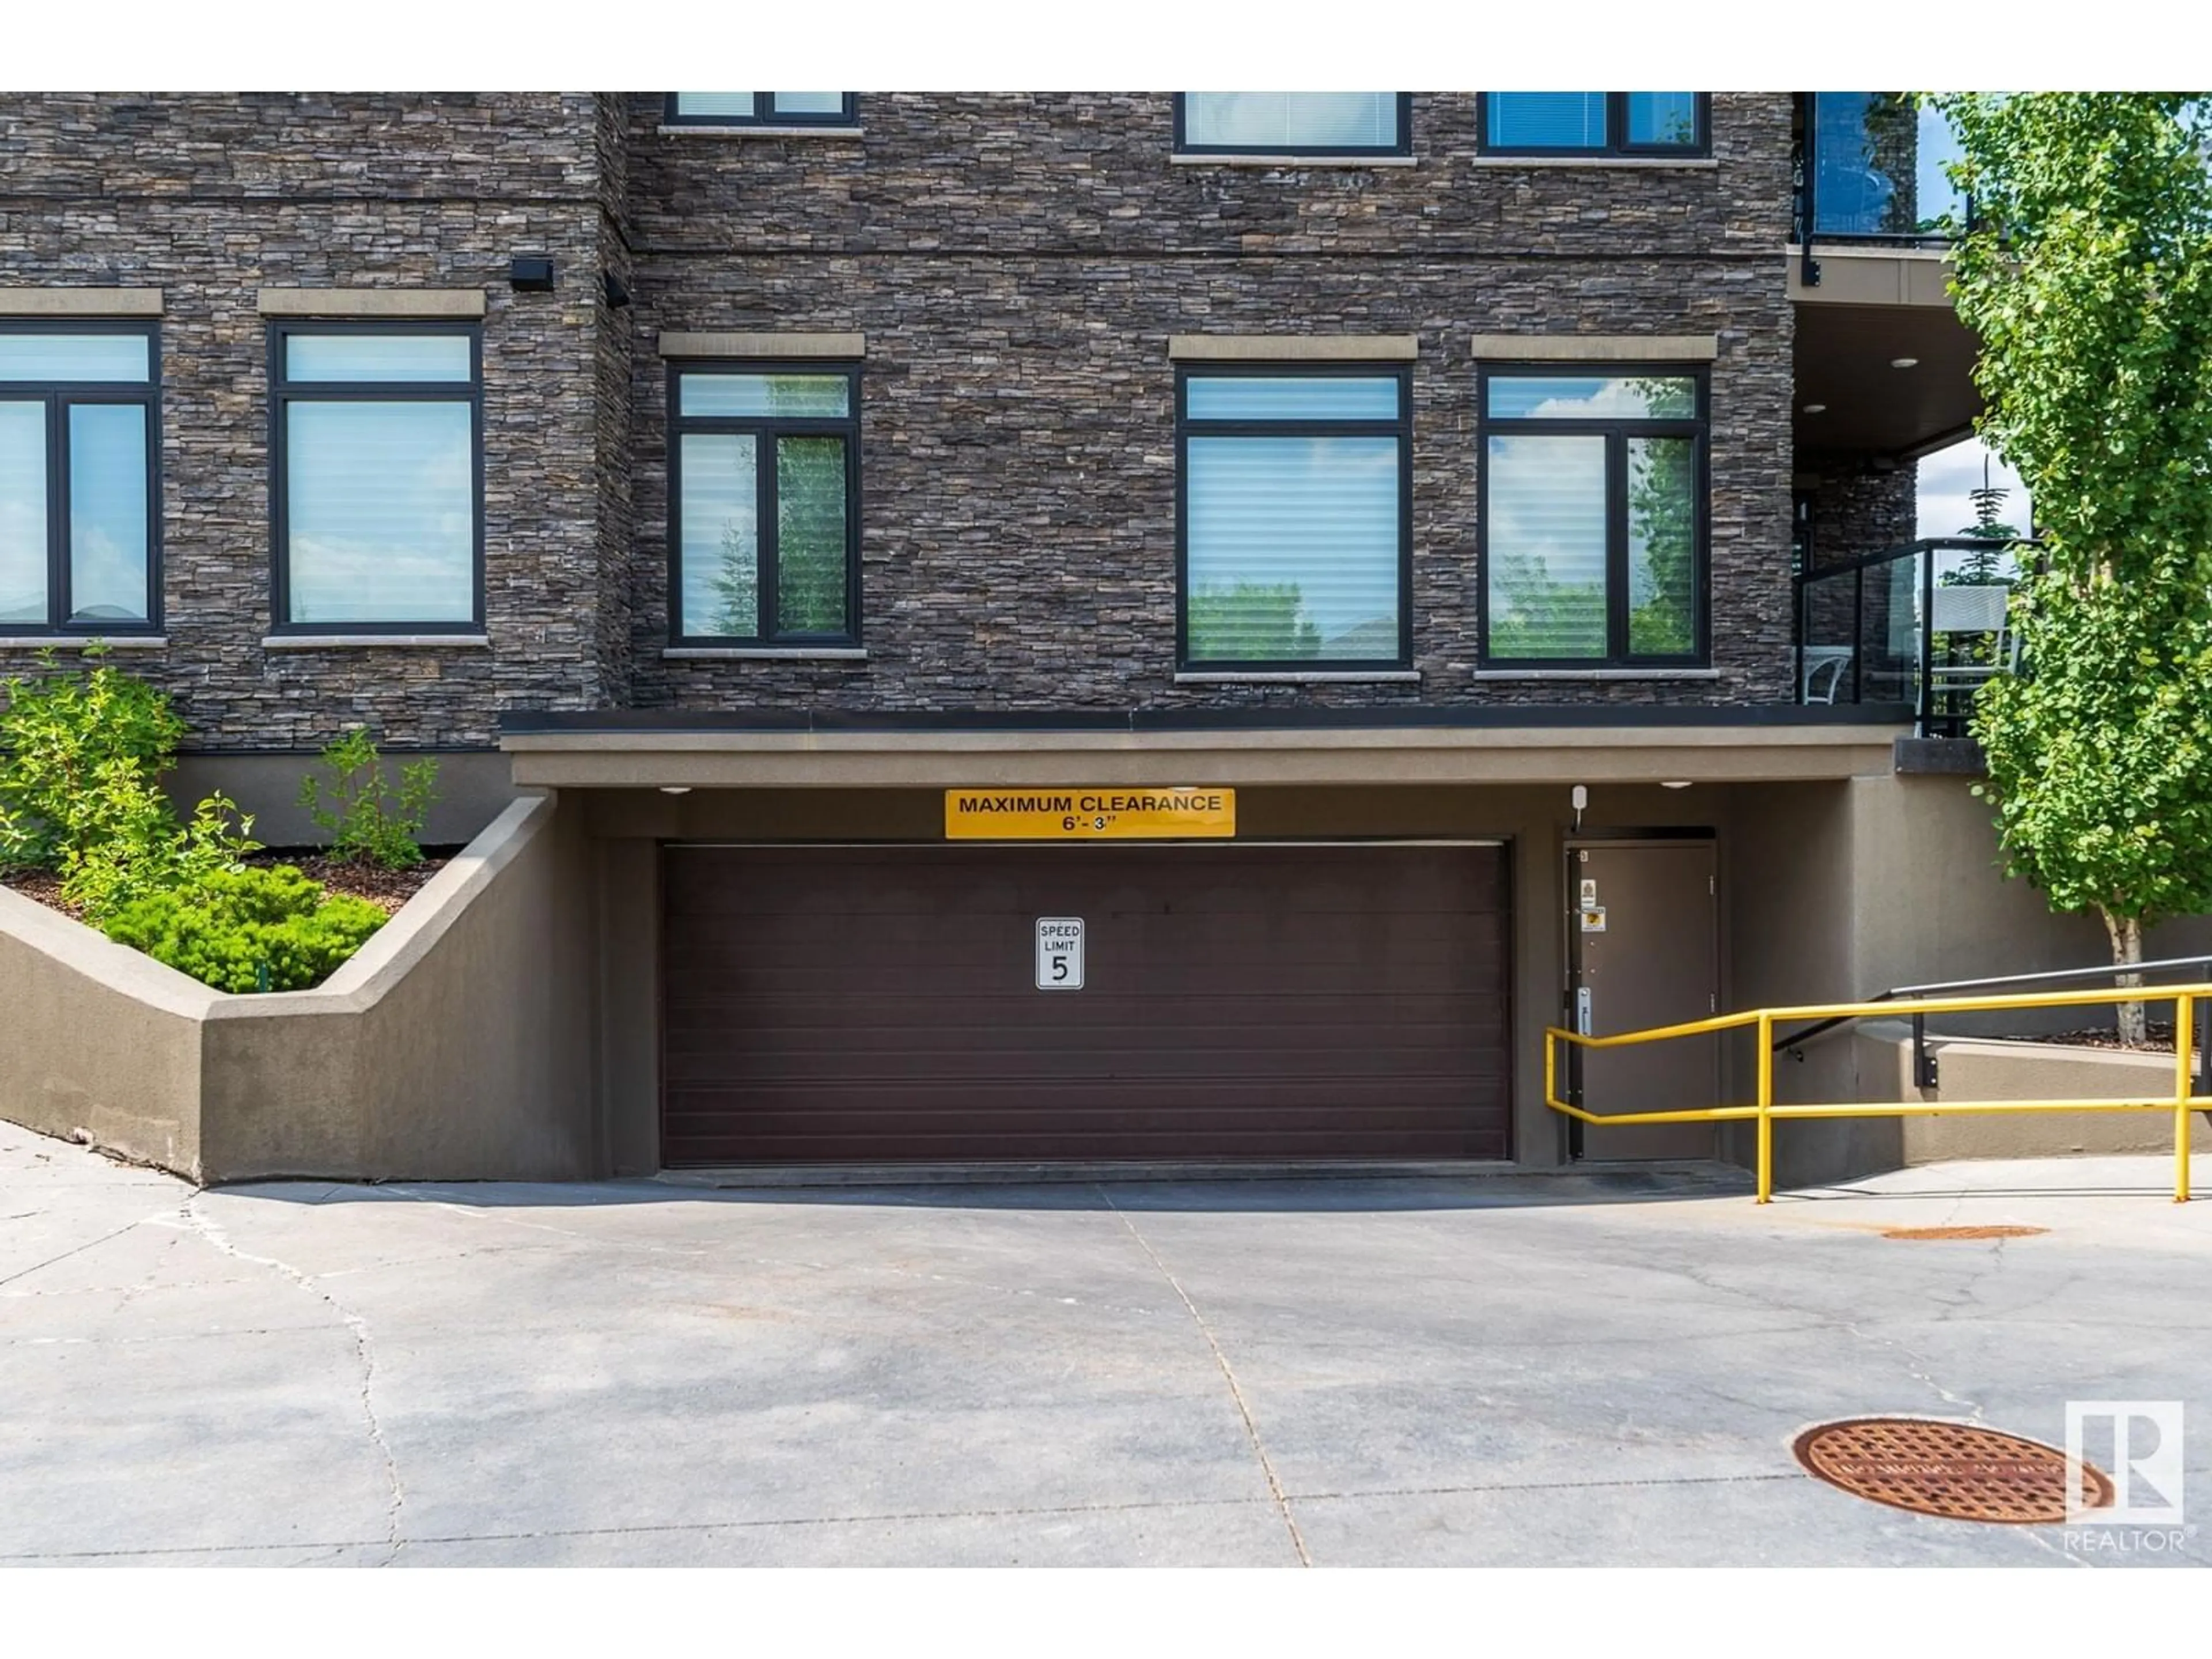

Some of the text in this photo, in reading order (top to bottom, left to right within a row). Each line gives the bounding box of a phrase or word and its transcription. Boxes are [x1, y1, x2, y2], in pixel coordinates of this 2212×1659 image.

[959, 796, 1222, 813] MAXIMUM CLEARANCE
[1041, 926, 1080, 937] SPEED
[1044, 941, 1074, 951] LIMIT
[1052, 956, 1068, 981] 5
